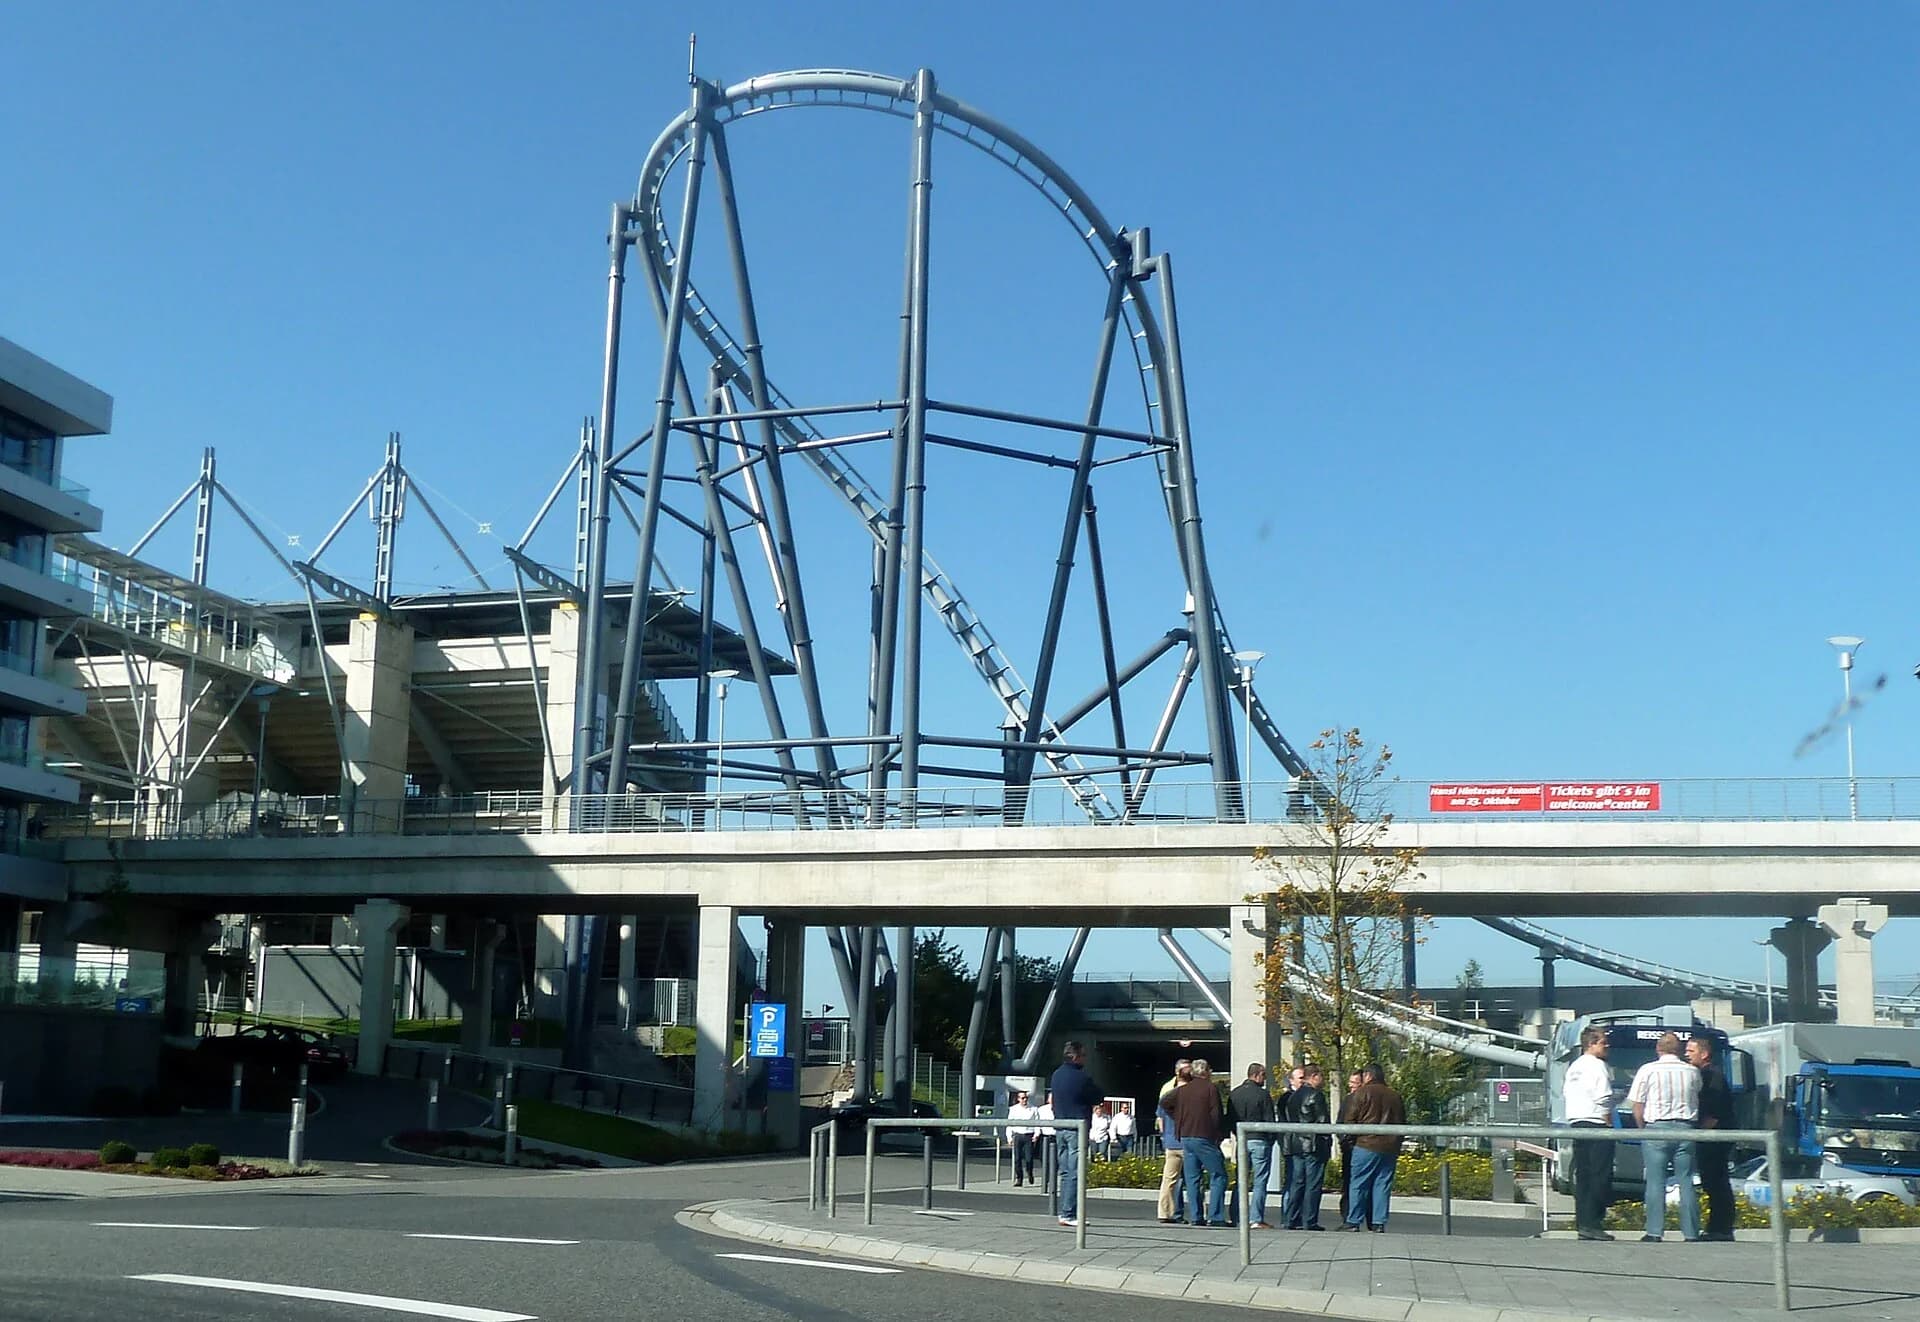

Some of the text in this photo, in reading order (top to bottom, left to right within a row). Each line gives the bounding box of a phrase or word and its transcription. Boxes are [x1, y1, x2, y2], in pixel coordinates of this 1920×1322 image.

[1550, 786, 1594, 796] Tickets
[1634, 785, 1651, 796] im
[1482, 797, 1521, 805] Oktober
[763, 1011, 775, 1028] P
